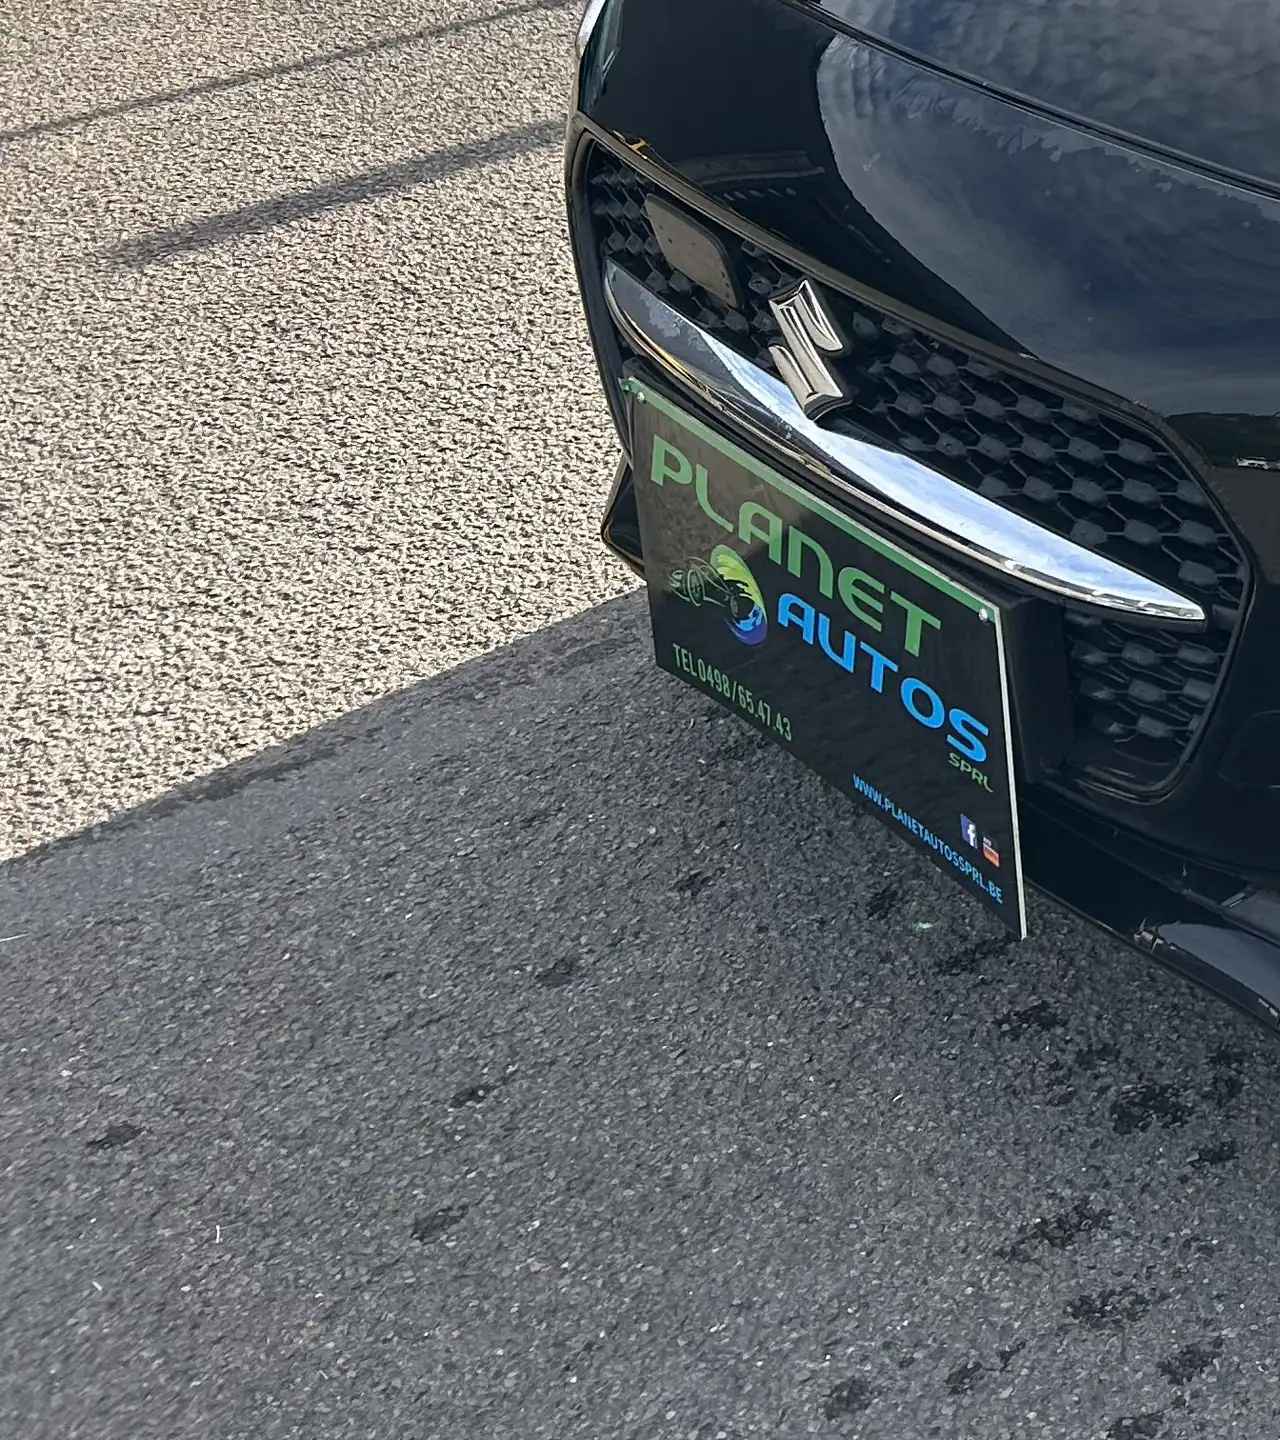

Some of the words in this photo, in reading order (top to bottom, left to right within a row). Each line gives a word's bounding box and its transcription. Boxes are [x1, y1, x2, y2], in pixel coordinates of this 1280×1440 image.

[650, 433, 942, 658] PLANET
[777, 592, 990, 762] AUTOS
[852, 772, 1003, 905] WWW.PLANETAUTOSSPRL.BE
[947, 752, 994, 794] SPRL
